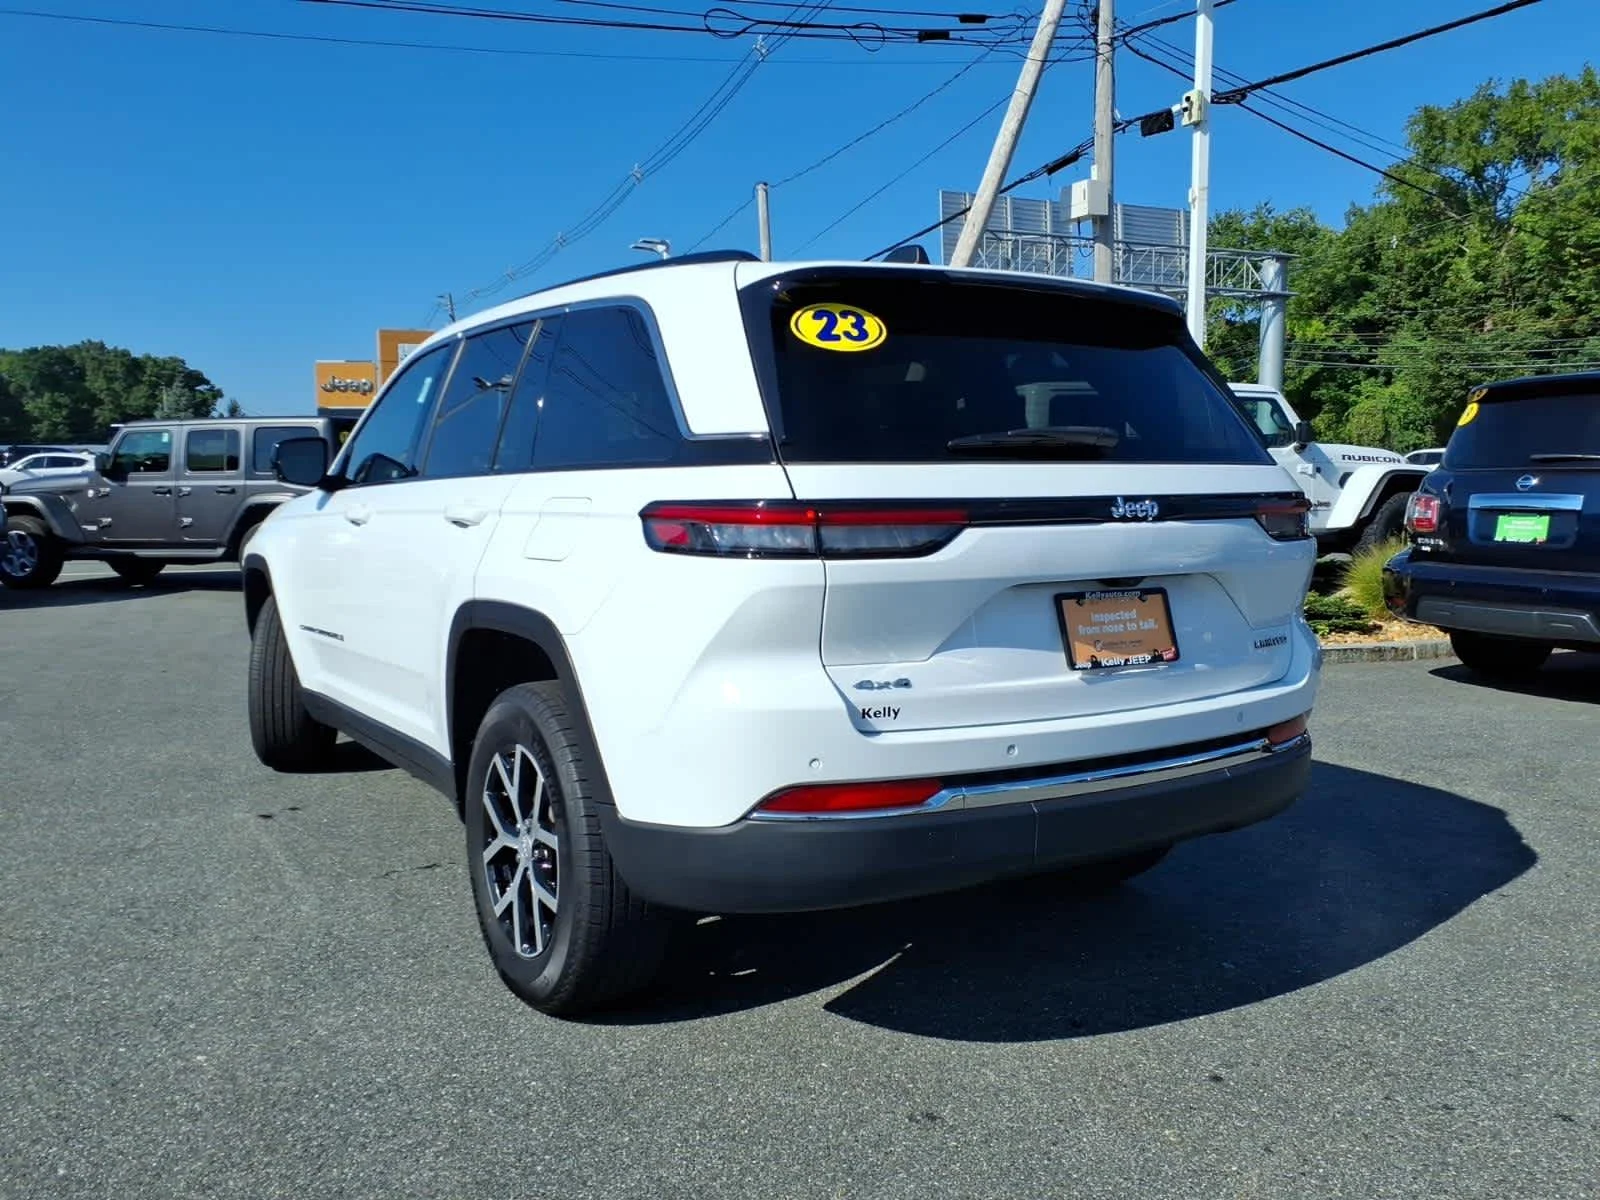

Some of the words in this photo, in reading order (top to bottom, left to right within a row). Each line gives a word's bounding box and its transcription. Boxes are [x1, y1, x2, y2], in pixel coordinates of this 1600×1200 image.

[812, 309, 869, 342] 23
[320, 375, 374, 396] Jeep
[1341, 453, 1401, 464] RUBICON
[1110, 496, 1159, 521] Jeep
[1091, 609, 1137, 624] Inspected
[1078, 624, 1100, 635] from
[1102, 623, 1125, 633] nose
[1126, 622, 1137, 631] to
[1100, 656, 1125, 667] Kelly
[1126, 655, 1152, 665] JEEP
[861, 706, 901, 720] Kelly
